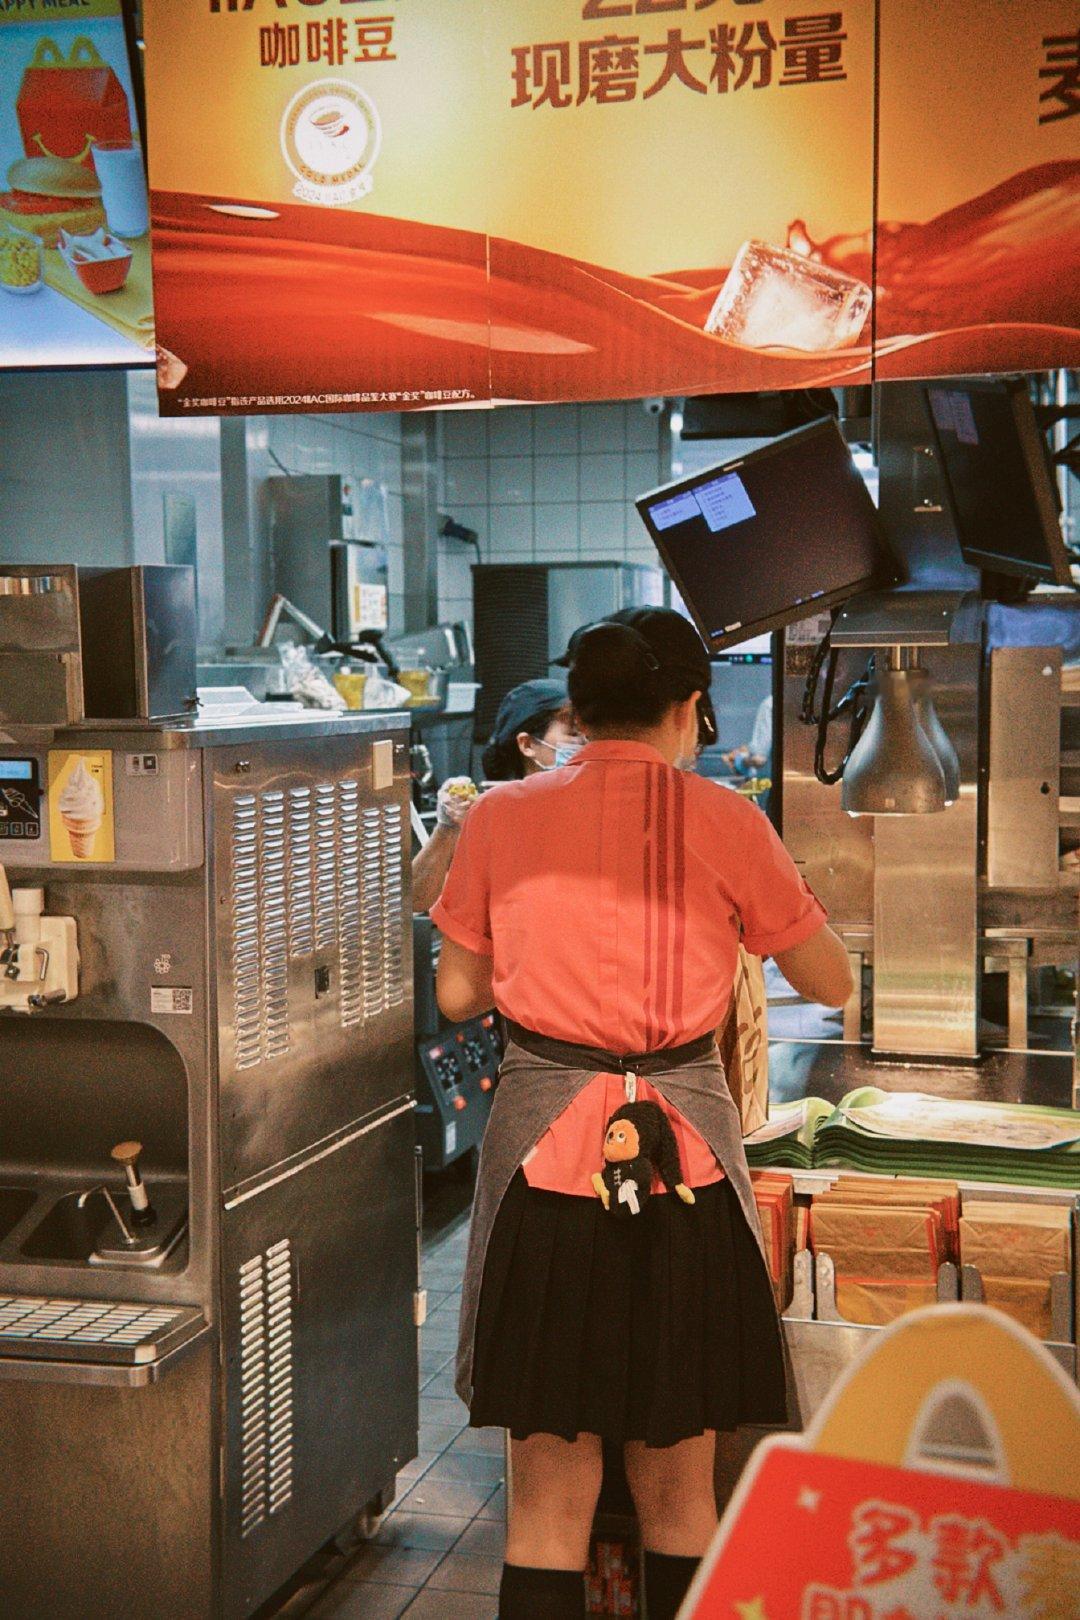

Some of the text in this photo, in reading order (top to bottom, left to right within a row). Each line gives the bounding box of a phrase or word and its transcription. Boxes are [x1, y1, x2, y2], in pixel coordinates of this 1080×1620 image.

[260, 16, 397, 68] 咖啡豆
[510, 12, 848, 110] 现磨大粉量
